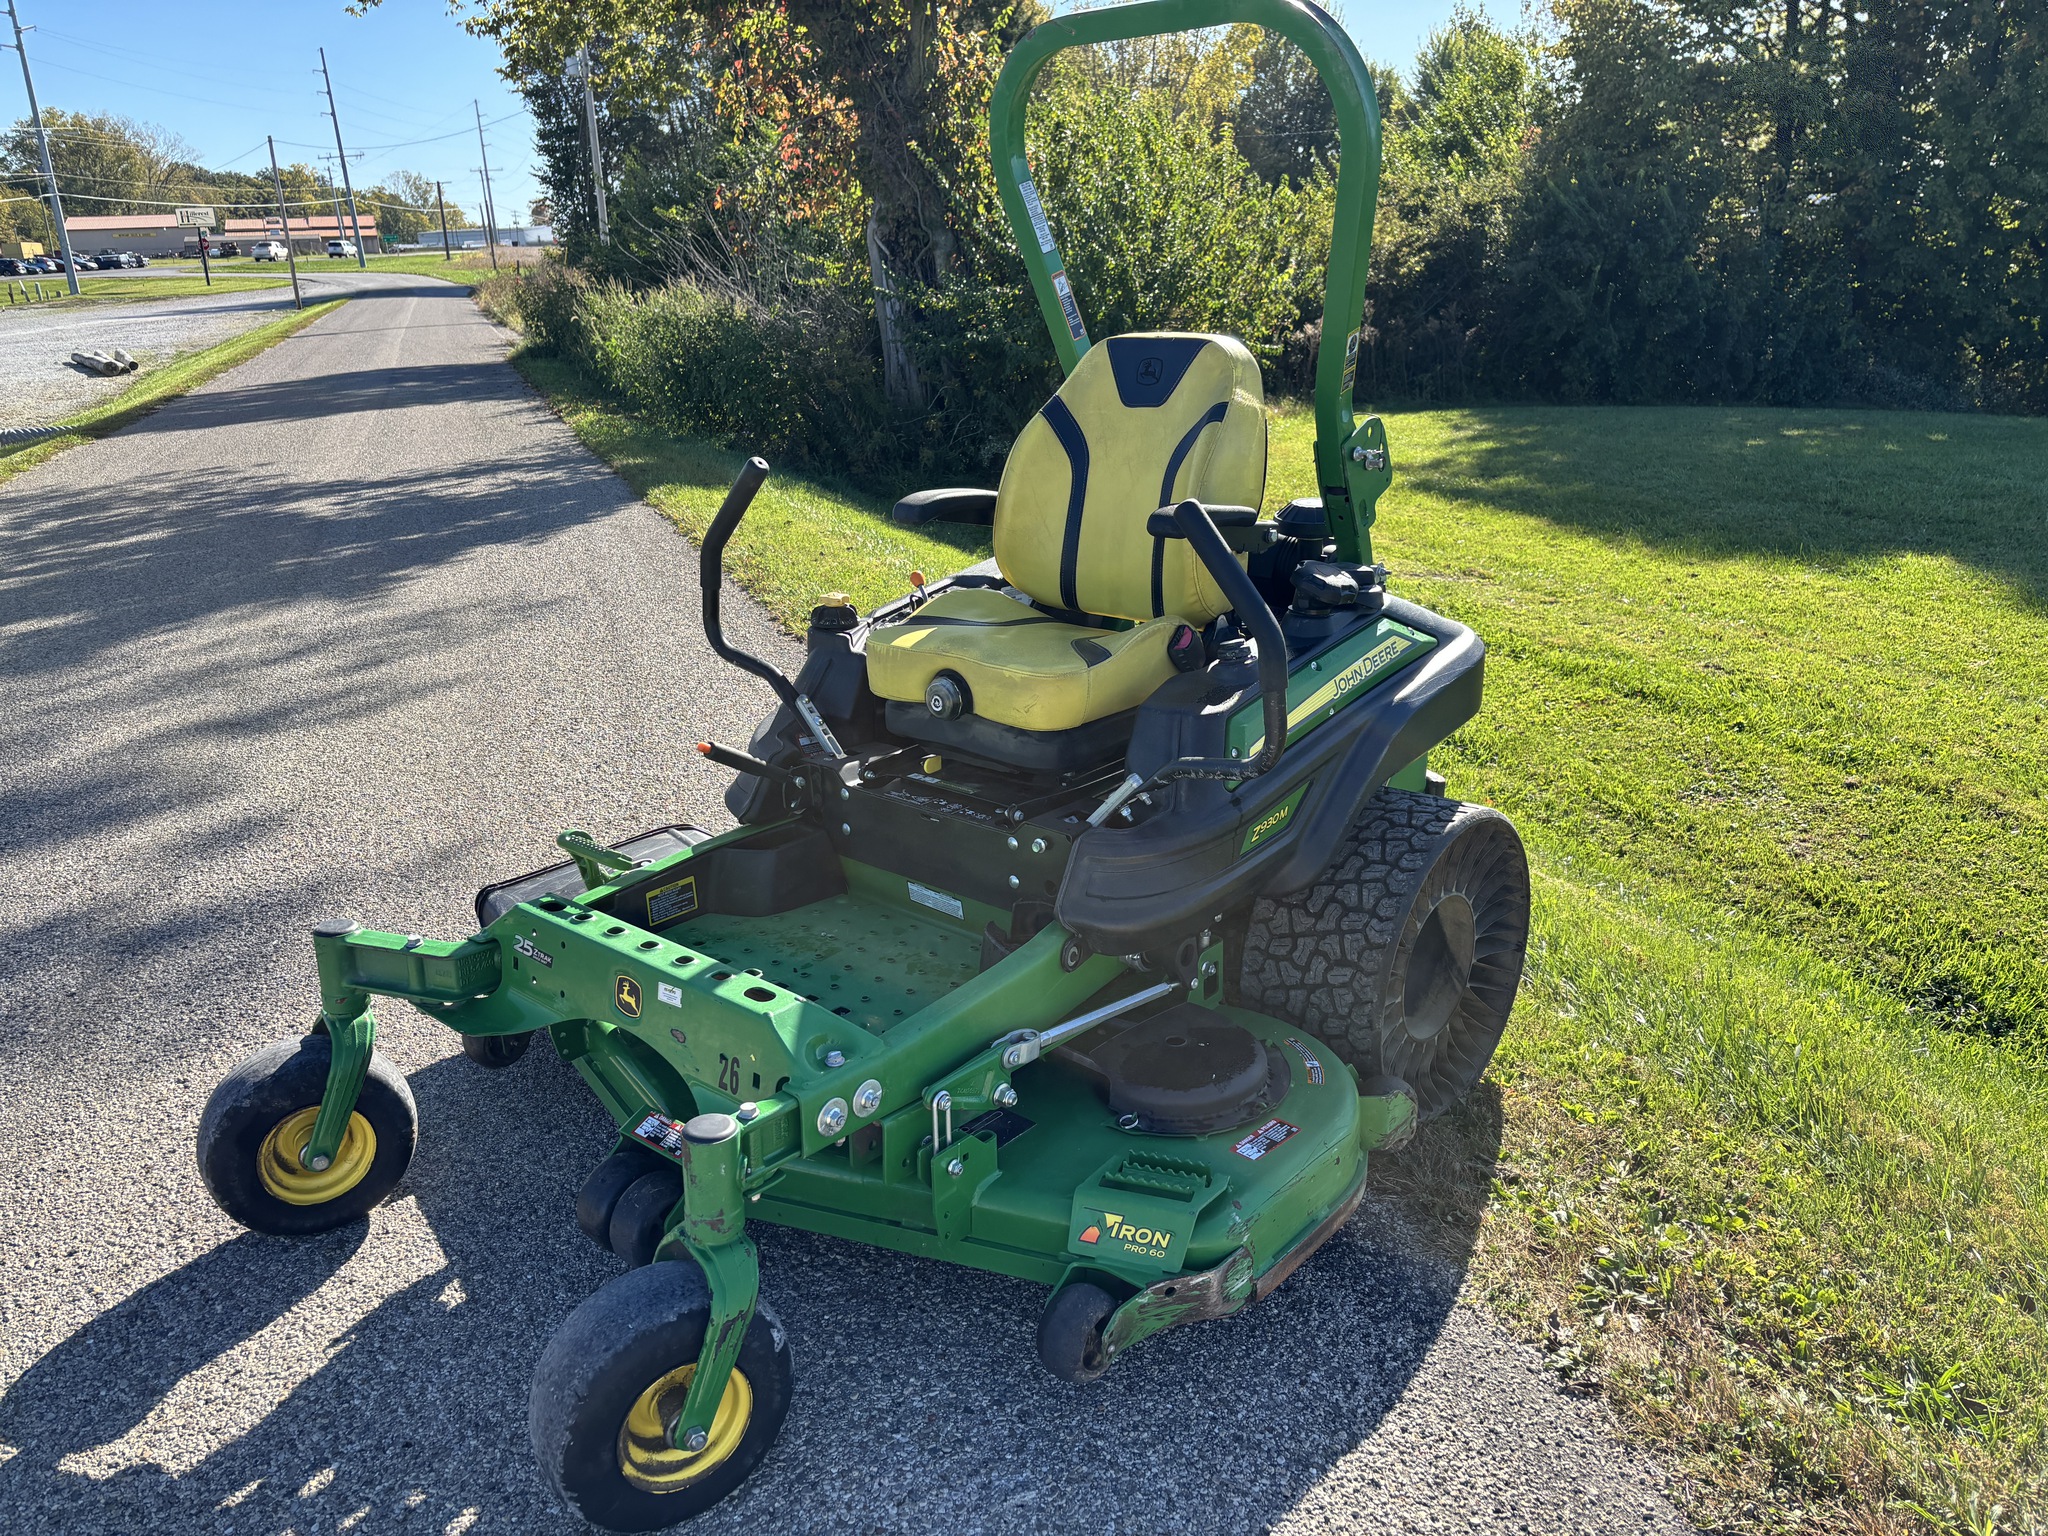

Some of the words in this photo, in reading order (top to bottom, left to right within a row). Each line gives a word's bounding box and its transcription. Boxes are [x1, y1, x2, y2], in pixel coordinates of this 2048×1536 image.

[1333, 666, 1364, 698] JOHN
[1362, 641, 1400, 675] DEERE
[1251, 805, 1289, 843] Z930M
[513, 934, 534, 957] 25
[718, 1052, 740, 1096] 26
[1110, 1222, 1171, 1249] IRON
[1122, 1243, 1147, 1255] PRO
[1149, 1249, 1165, 1258] 60
